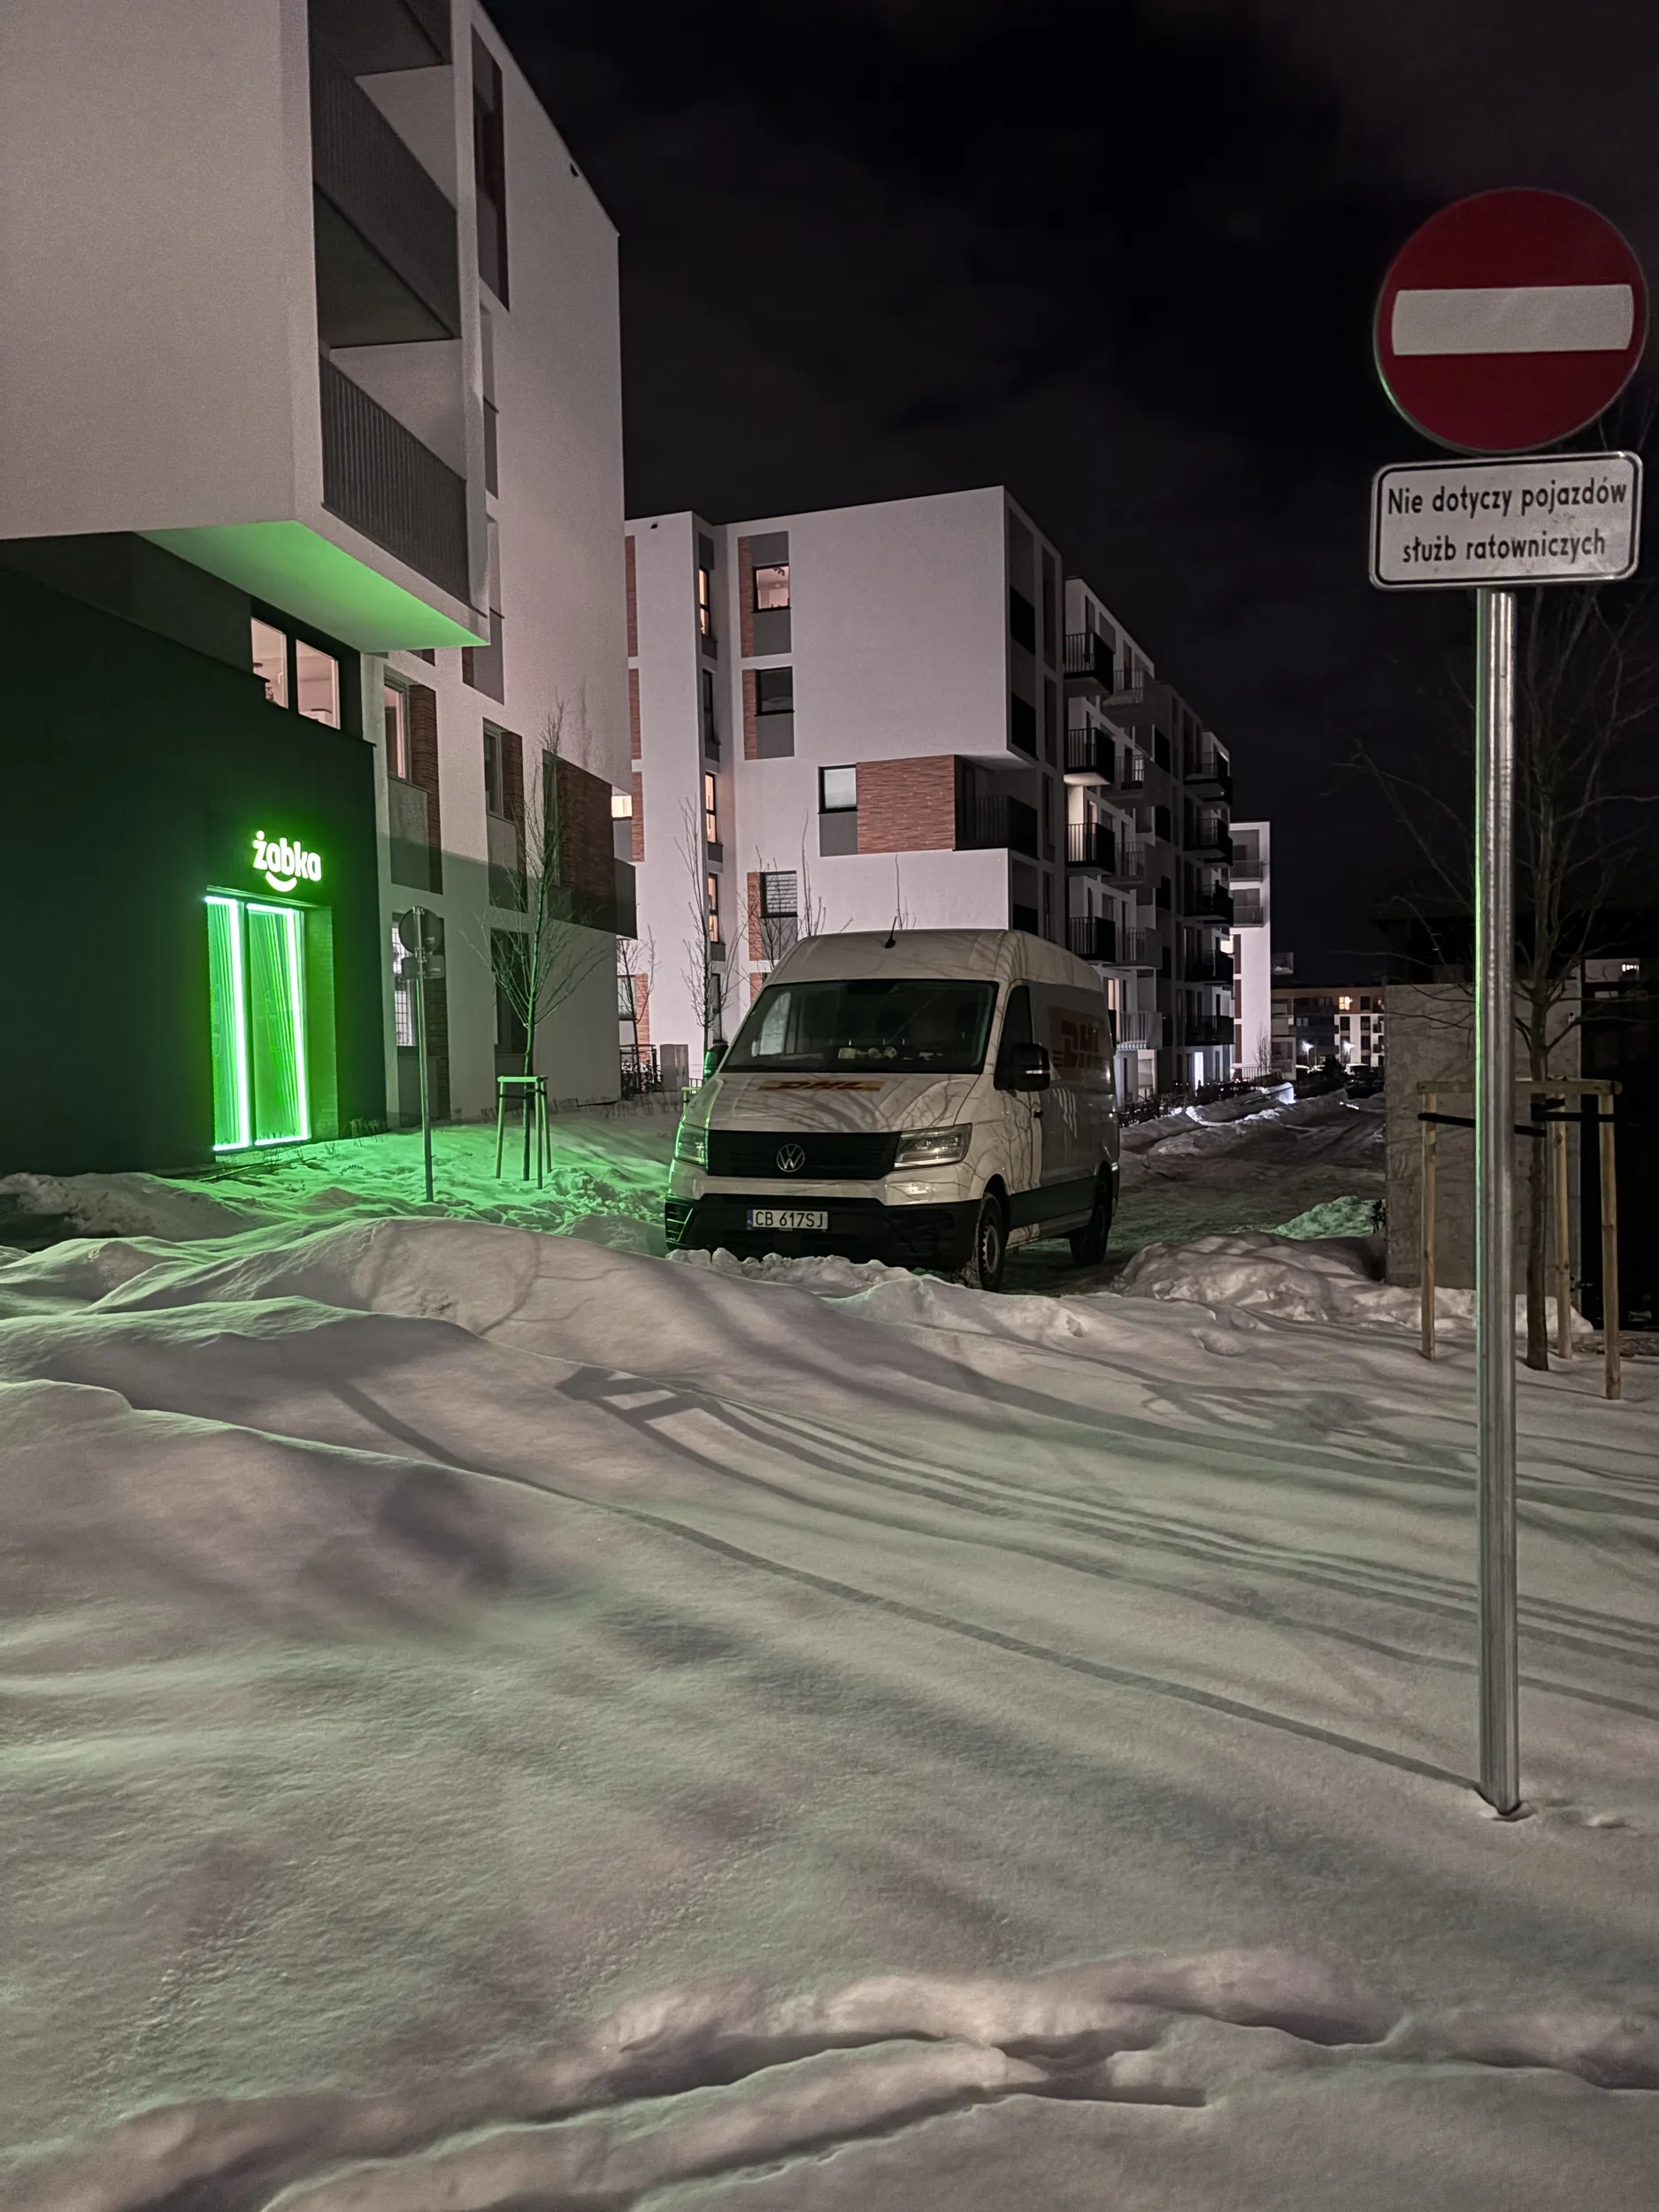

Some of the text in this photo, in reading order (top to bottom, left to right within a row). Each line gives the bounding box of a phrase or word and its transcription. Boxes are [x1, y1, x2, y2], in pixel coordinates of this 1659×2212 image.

[1387, 476, 1627, 519] Nie dotyczy pojazdów
[1402, 528, 1606, 565] służb ratowniczych
[252, 830, 322, 882] żabka
[777, 1080, 864, 1090] DHL
[755, 1211, 774, 1226] CB
[779, 1212, 823, 1228] 617SJ
